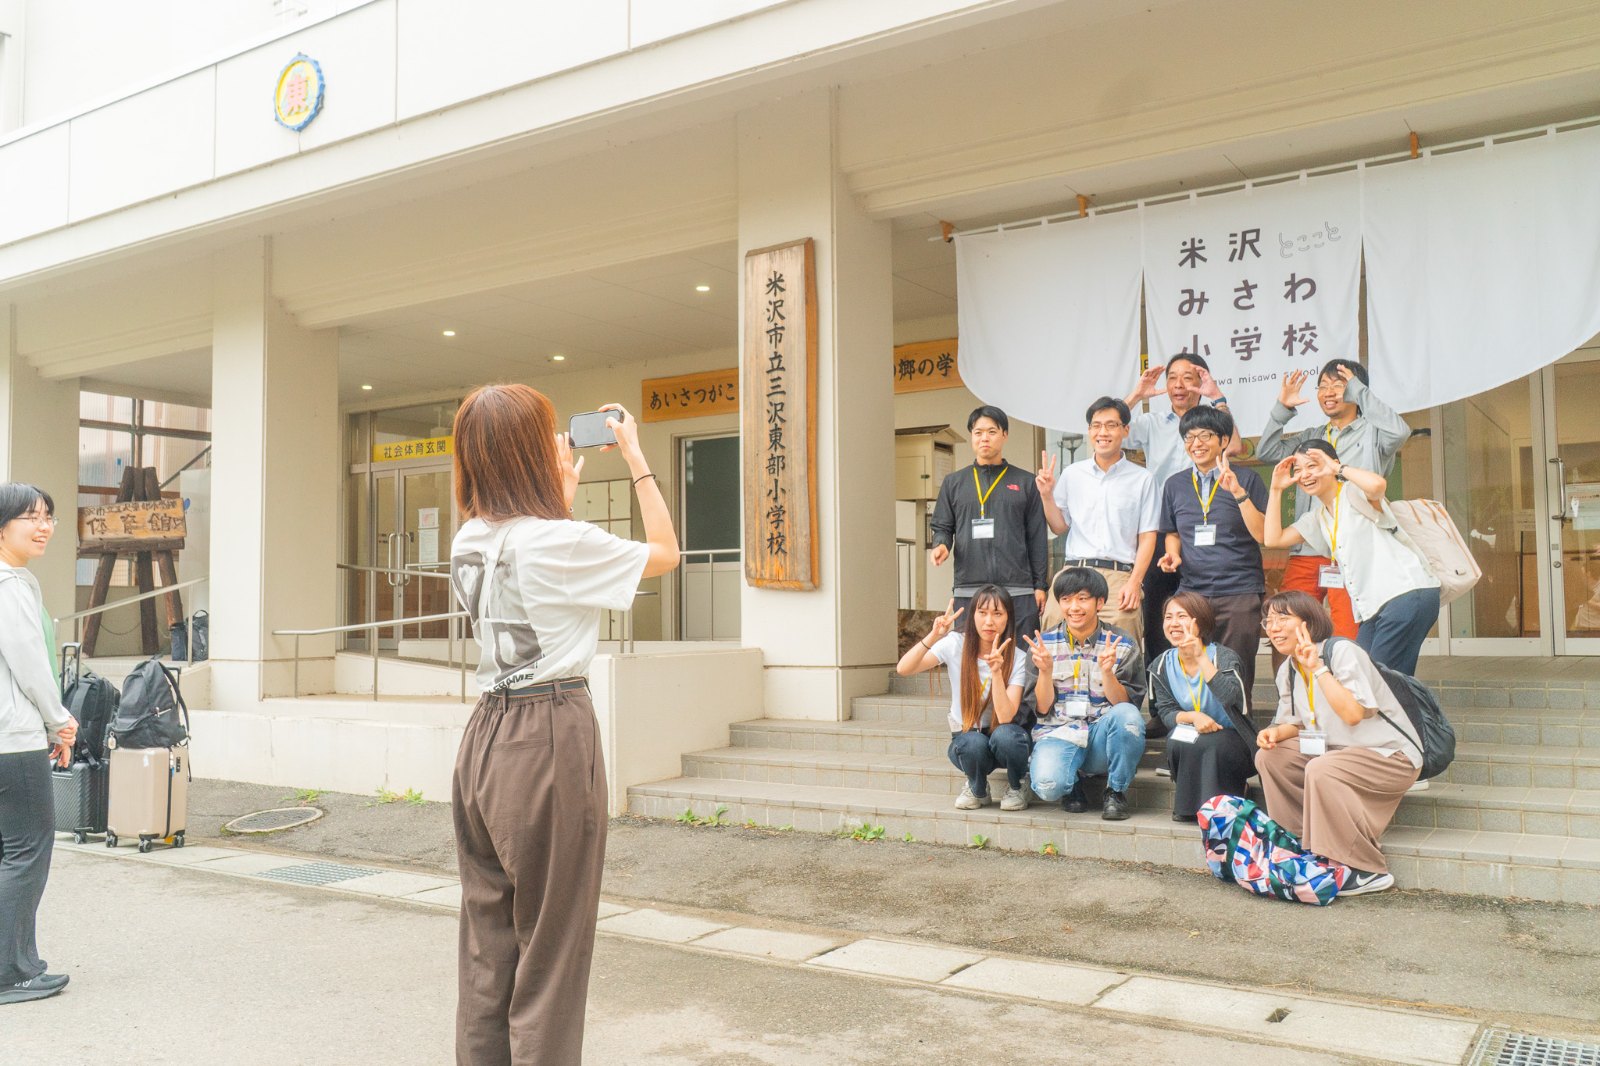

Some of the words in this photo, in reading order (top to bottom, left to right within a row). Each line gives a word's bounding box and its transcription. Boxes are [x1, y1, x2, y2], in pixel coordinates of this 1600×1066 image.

[1178, 228, 1262, 268] 米沢
[1178, 272, 1317, 317] みさわ
[1181, 322, 1320, 361] 小学校
[894, 352, 954, 381] 郷の学
[1239, 373, 1277, 384] misawa
[650, 384, 735, 410] あいさつがこ
[765, 270, 788, 556] 米沢市立三沢東部小学校
[383, 440, 446, 459] 社会体育玄関
